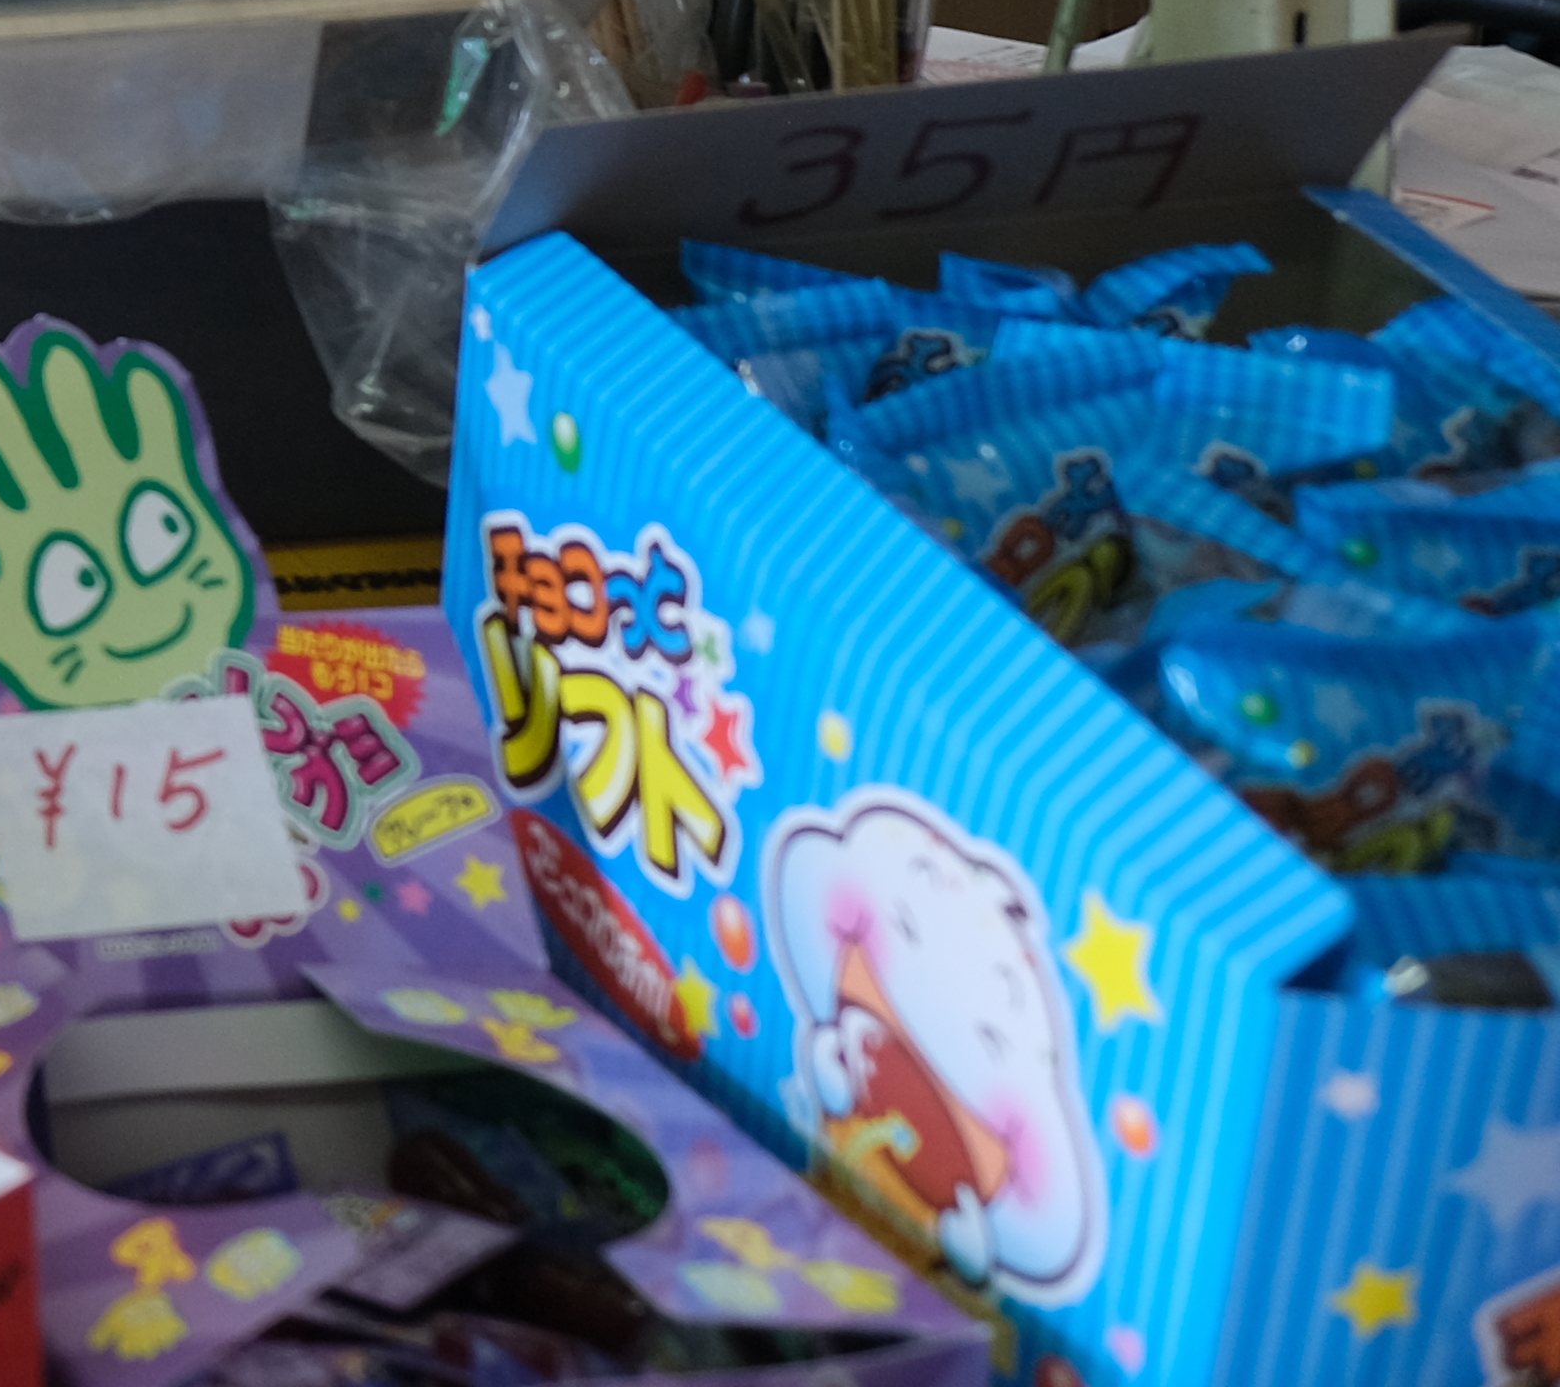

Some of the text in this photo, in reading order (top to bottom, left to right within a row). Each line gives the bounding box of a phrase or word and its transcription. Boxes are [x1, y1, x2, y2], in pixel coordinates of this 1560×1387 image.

[737, 107, 1205, 230] 35円
[276, 624, 428, 680] 当たりが出たら
[487, 525, 694, 664] チョコっと
[31, 739, 228, 853] ¥15
